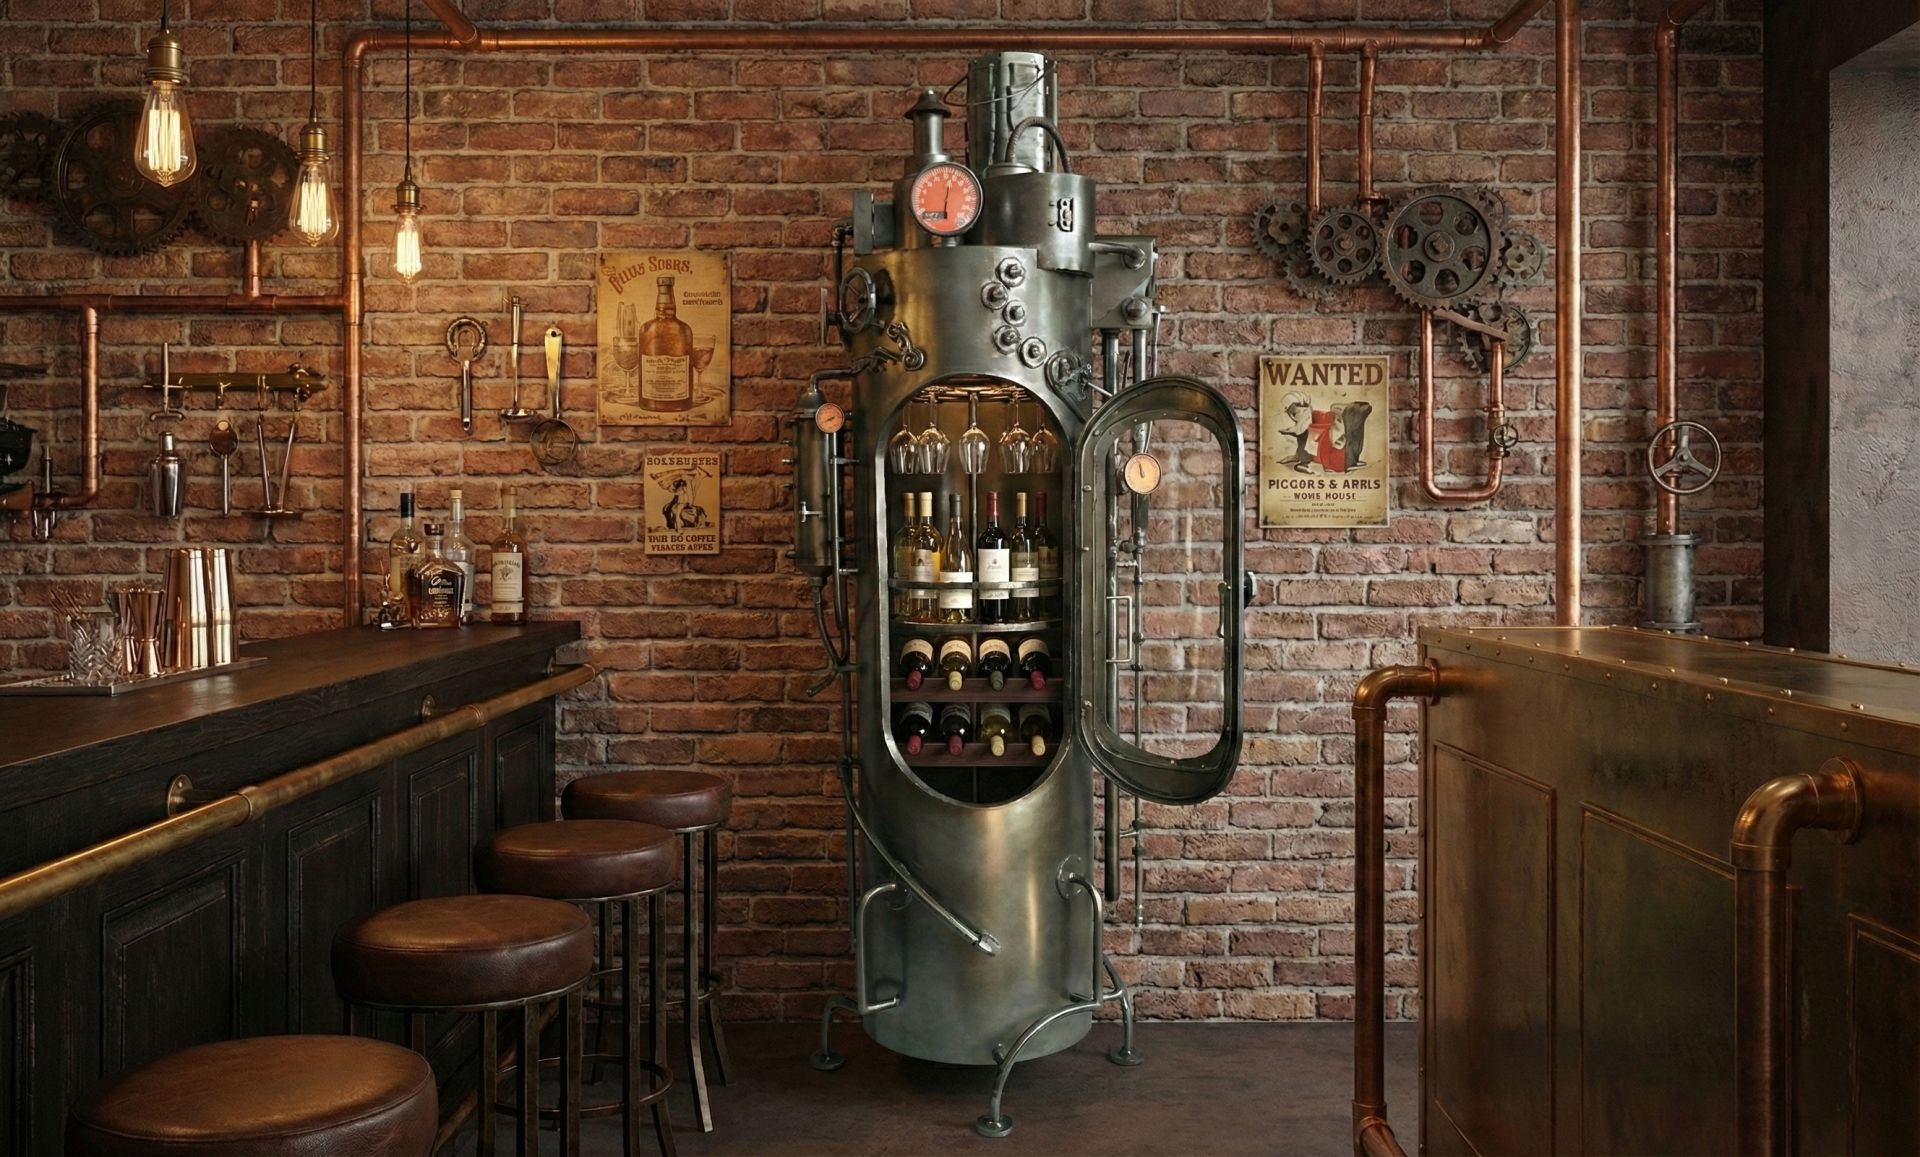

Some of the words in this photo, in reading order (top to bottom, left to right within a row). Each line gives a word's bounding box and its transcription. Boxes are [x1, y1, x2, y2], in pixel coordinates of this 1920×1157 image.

[1267, 363, 1383, 386] WANTED
[1328, 479, 1337, 489] &
[685, 534, 717, 543] COFFEE
